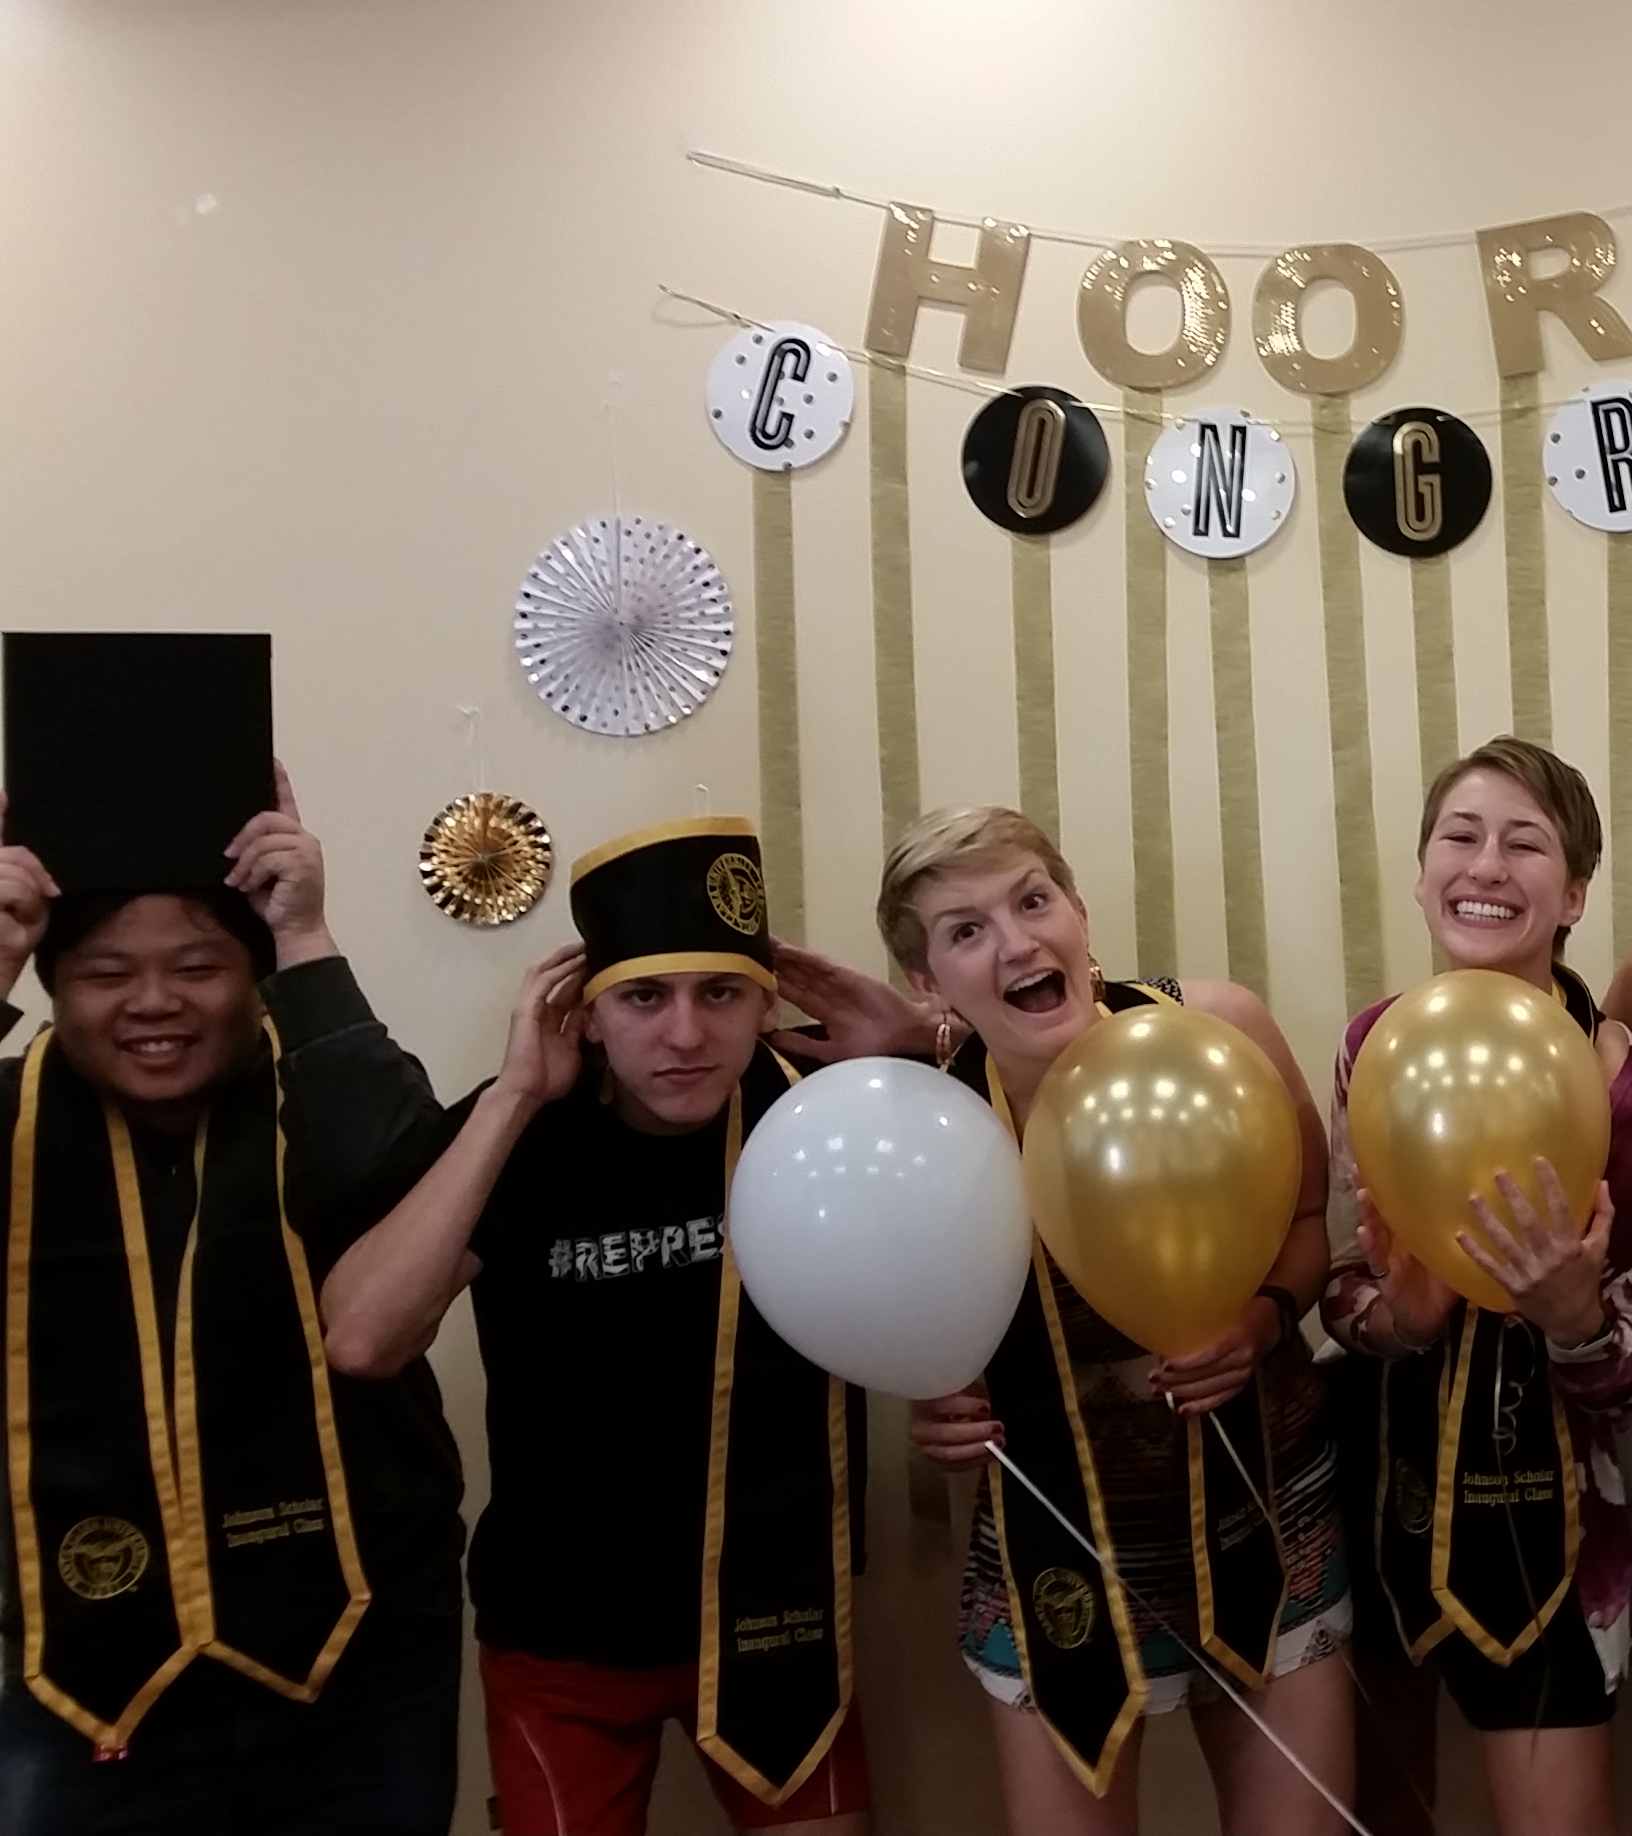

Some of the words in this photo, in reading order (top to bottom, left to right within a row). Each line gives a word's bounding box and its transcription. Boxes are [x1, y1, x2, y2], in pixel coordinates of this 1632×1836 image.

[548, 1212, 724, 1282] #REPRE
[1461, 1471, 1509, 1486] Johnson
[1513, 1468, 1555, 1485] Scholar
[1524, 1486, 1554, 1502] Class
